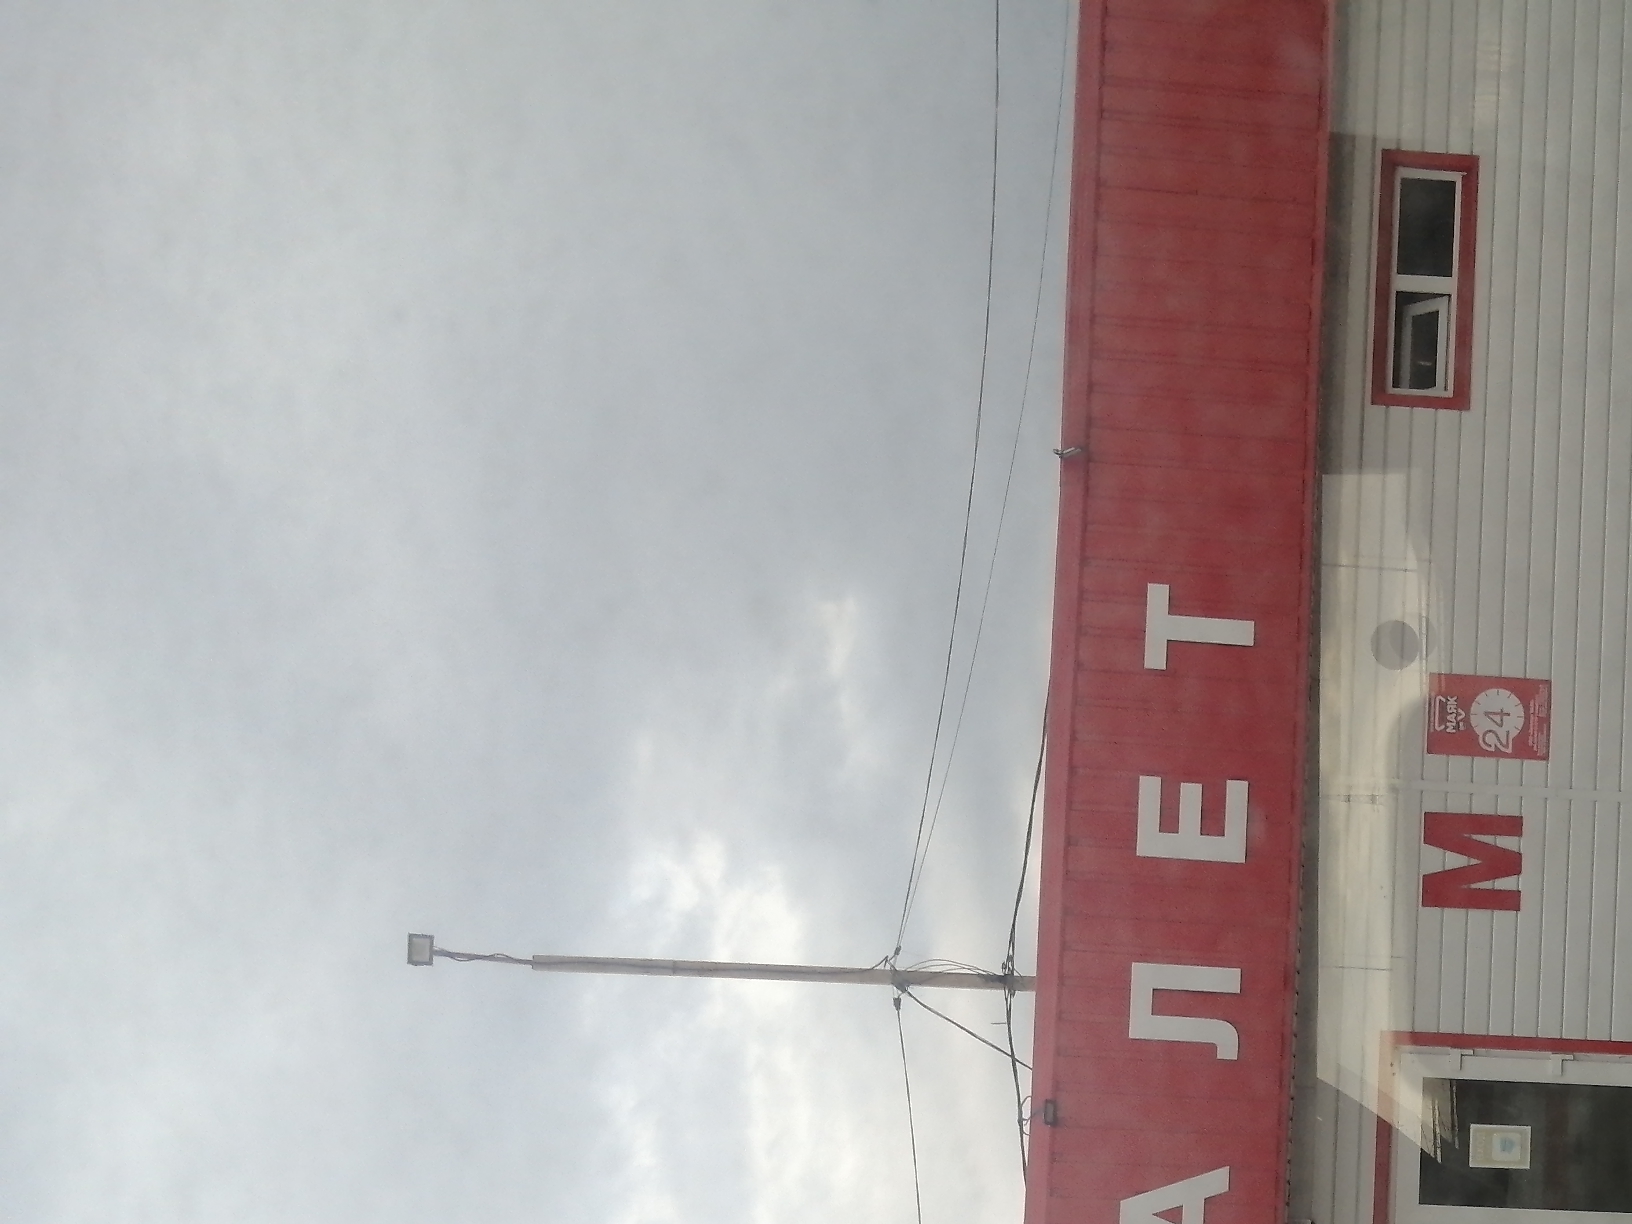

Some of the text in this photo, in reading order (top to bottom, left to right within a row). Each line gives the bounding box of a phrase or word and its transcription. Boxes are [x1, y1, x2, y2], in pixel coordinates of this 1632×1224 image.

[1446, 695, 1458, 733] МАЯК
[1481, 708, 1511, 750] 24
[1422, 812, 1523, 911] М
